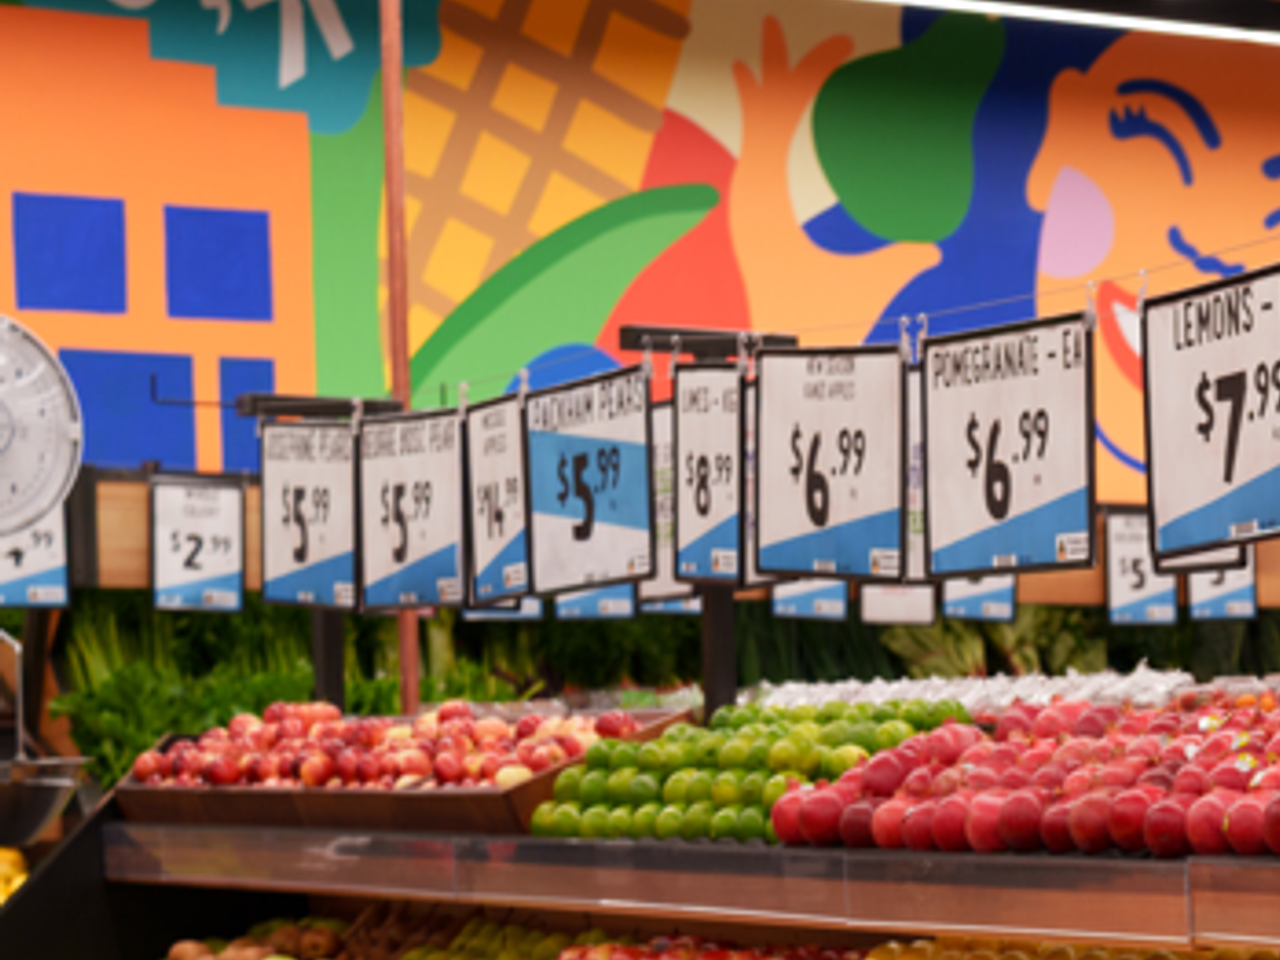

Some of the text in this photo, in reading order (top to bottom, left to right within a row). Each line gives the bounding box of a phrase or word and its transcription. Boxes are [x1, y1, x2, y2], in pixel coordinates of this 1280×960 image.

[1173, 286, 1254, 351] LEMONS
[933, 335, 1039, 390] POMEGRANATE
[557, 445, 621, 542] $5.99
[685, 453, 732, 517] $8.99
[790, 421, 866, 527] $6.99
[966, 408, 1050, 520] $6.99
[282, 482, 330, 563] $5.99
[381, 480, 432, 563] $5.99
